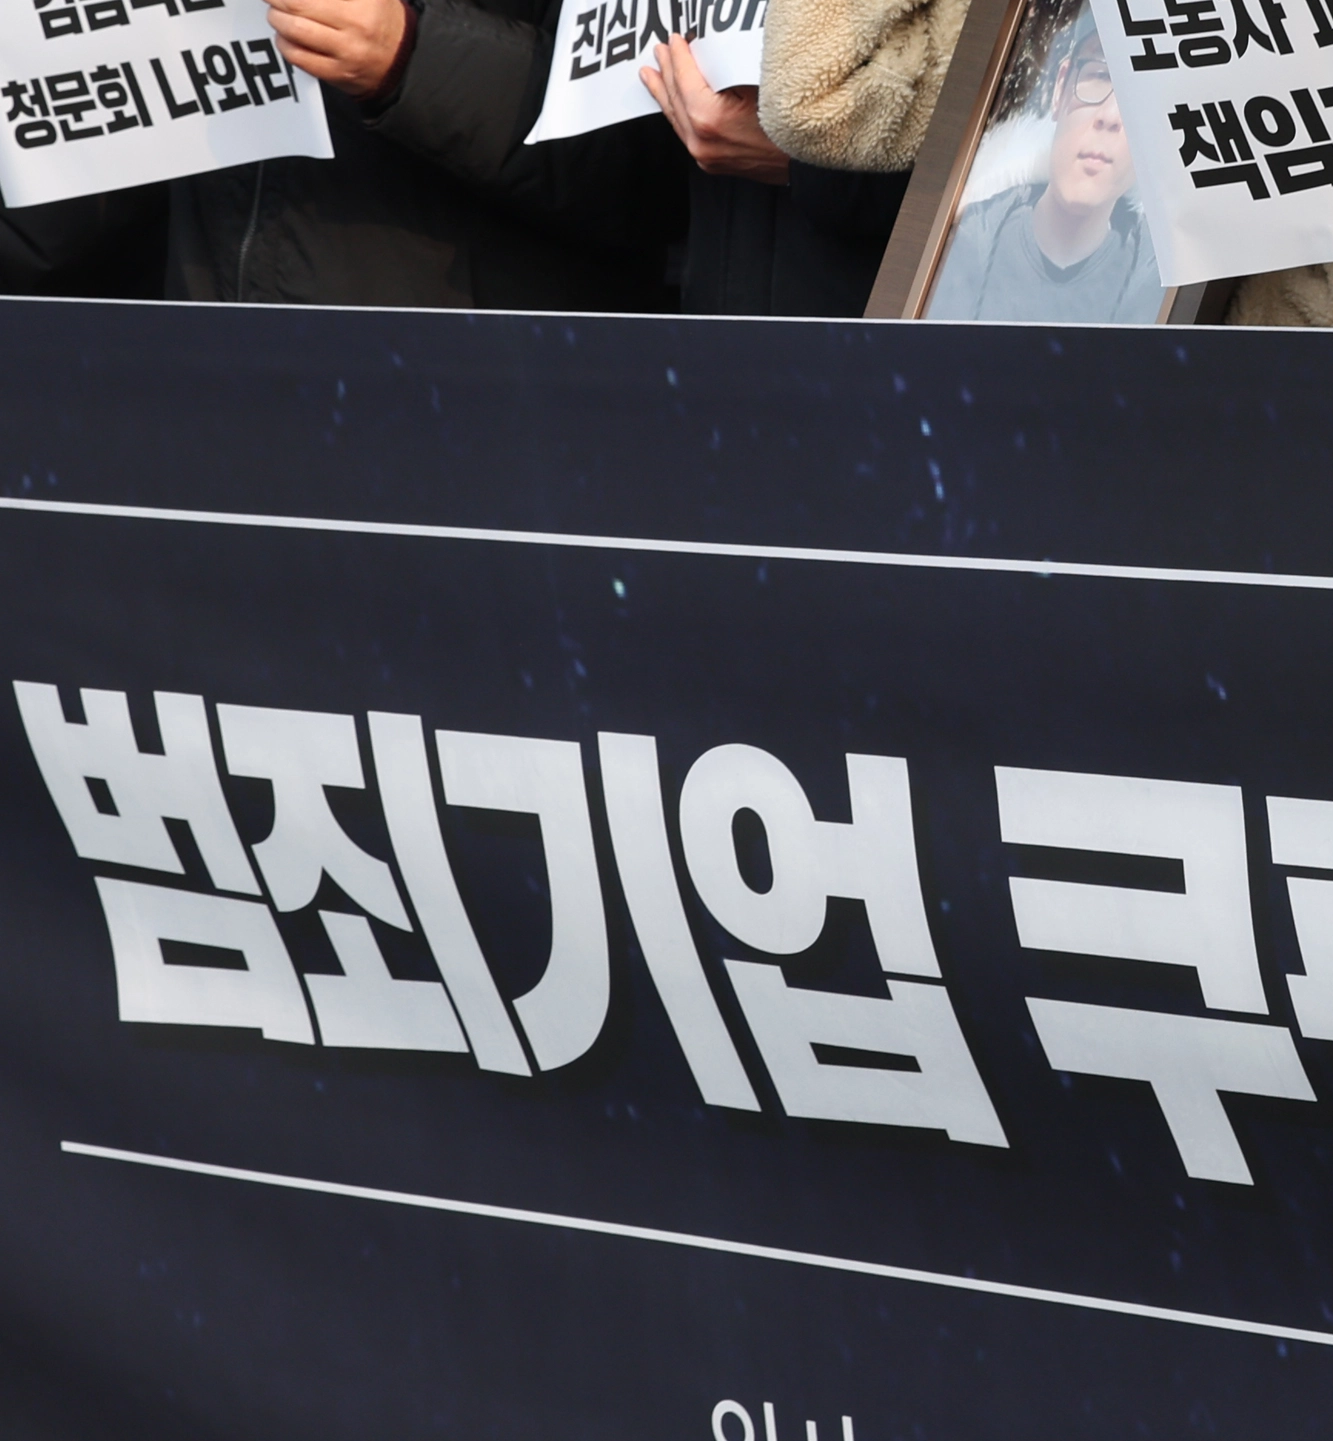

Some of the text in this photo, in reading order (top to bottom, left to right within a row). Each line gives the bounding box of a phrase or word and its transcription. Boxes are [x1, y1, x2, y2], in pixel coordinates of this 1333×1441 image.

[1, 37, 299, 150] 청문회 나와라
[12, 680, 1010, 1149] 범죄기업
